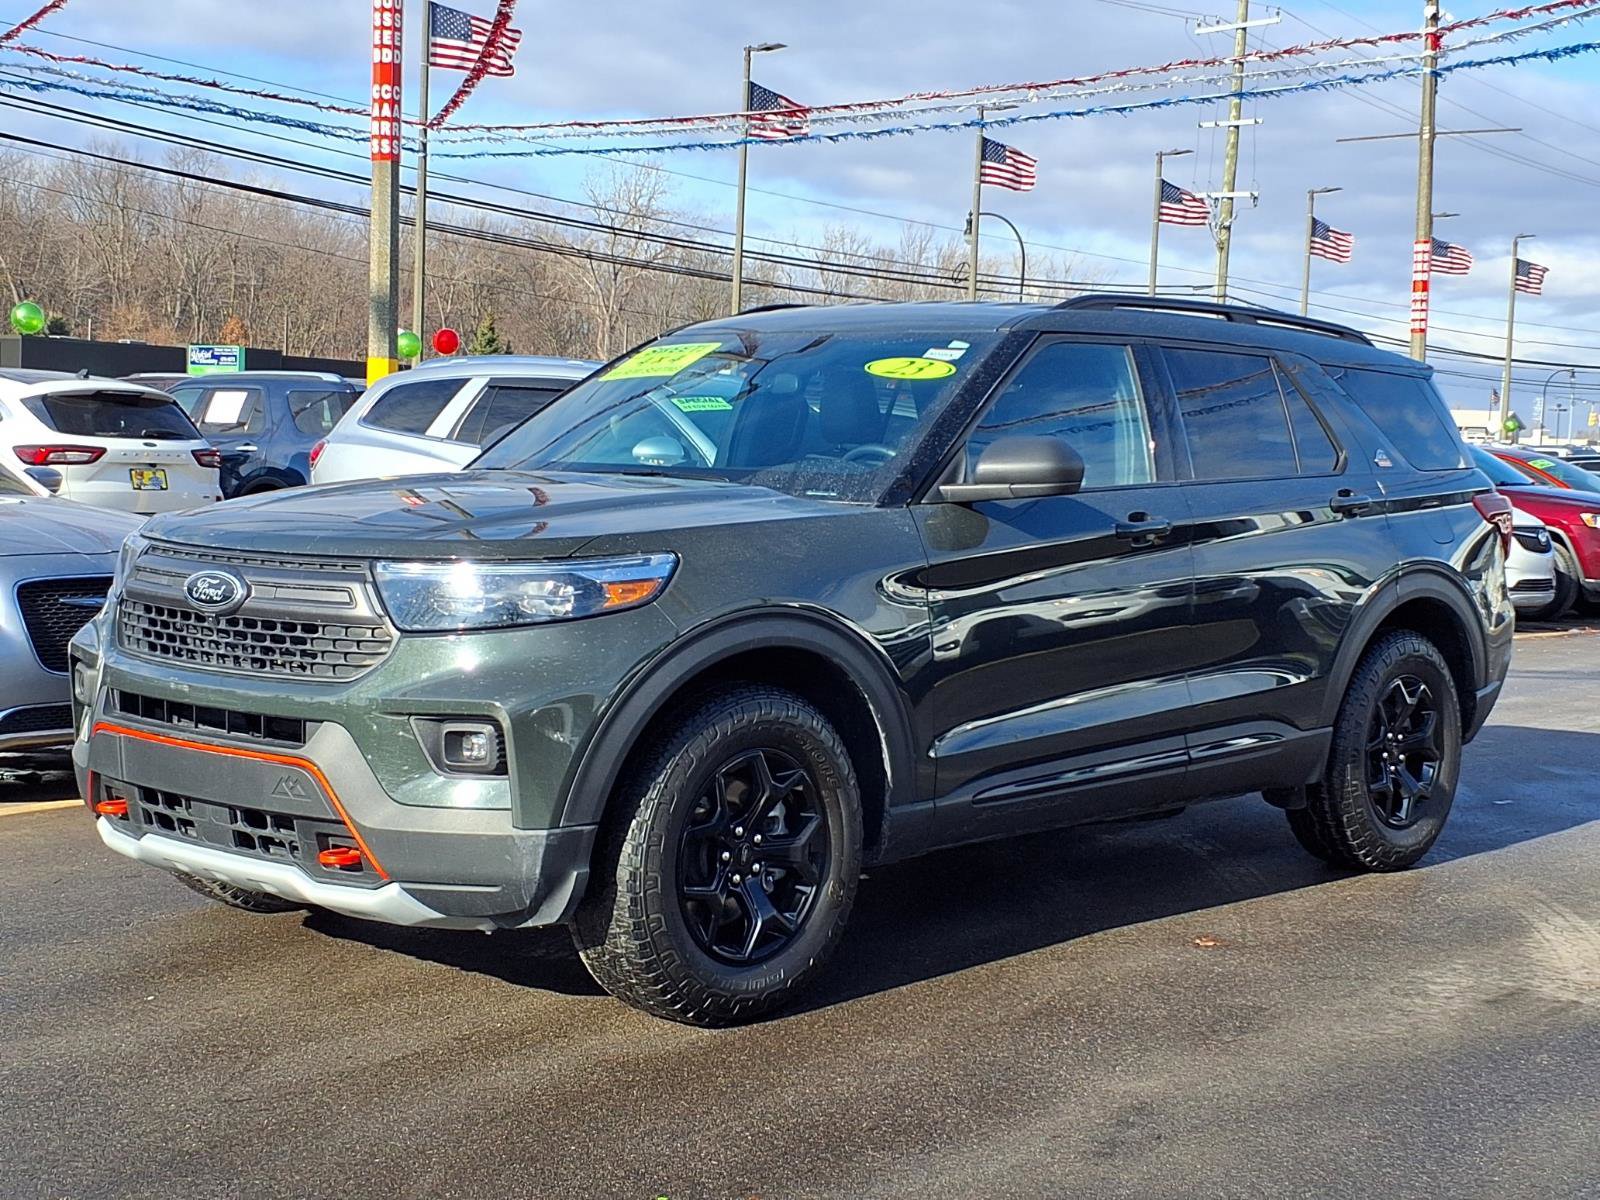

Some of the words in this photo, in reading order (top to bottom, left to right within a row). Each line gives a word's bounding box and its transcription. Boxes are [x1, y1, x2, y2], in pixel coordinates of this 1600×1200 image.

[380, 84, 392, 154] CARS
[880, 361, 934, 375] 23
[192, 577, 226, 601] Ford
